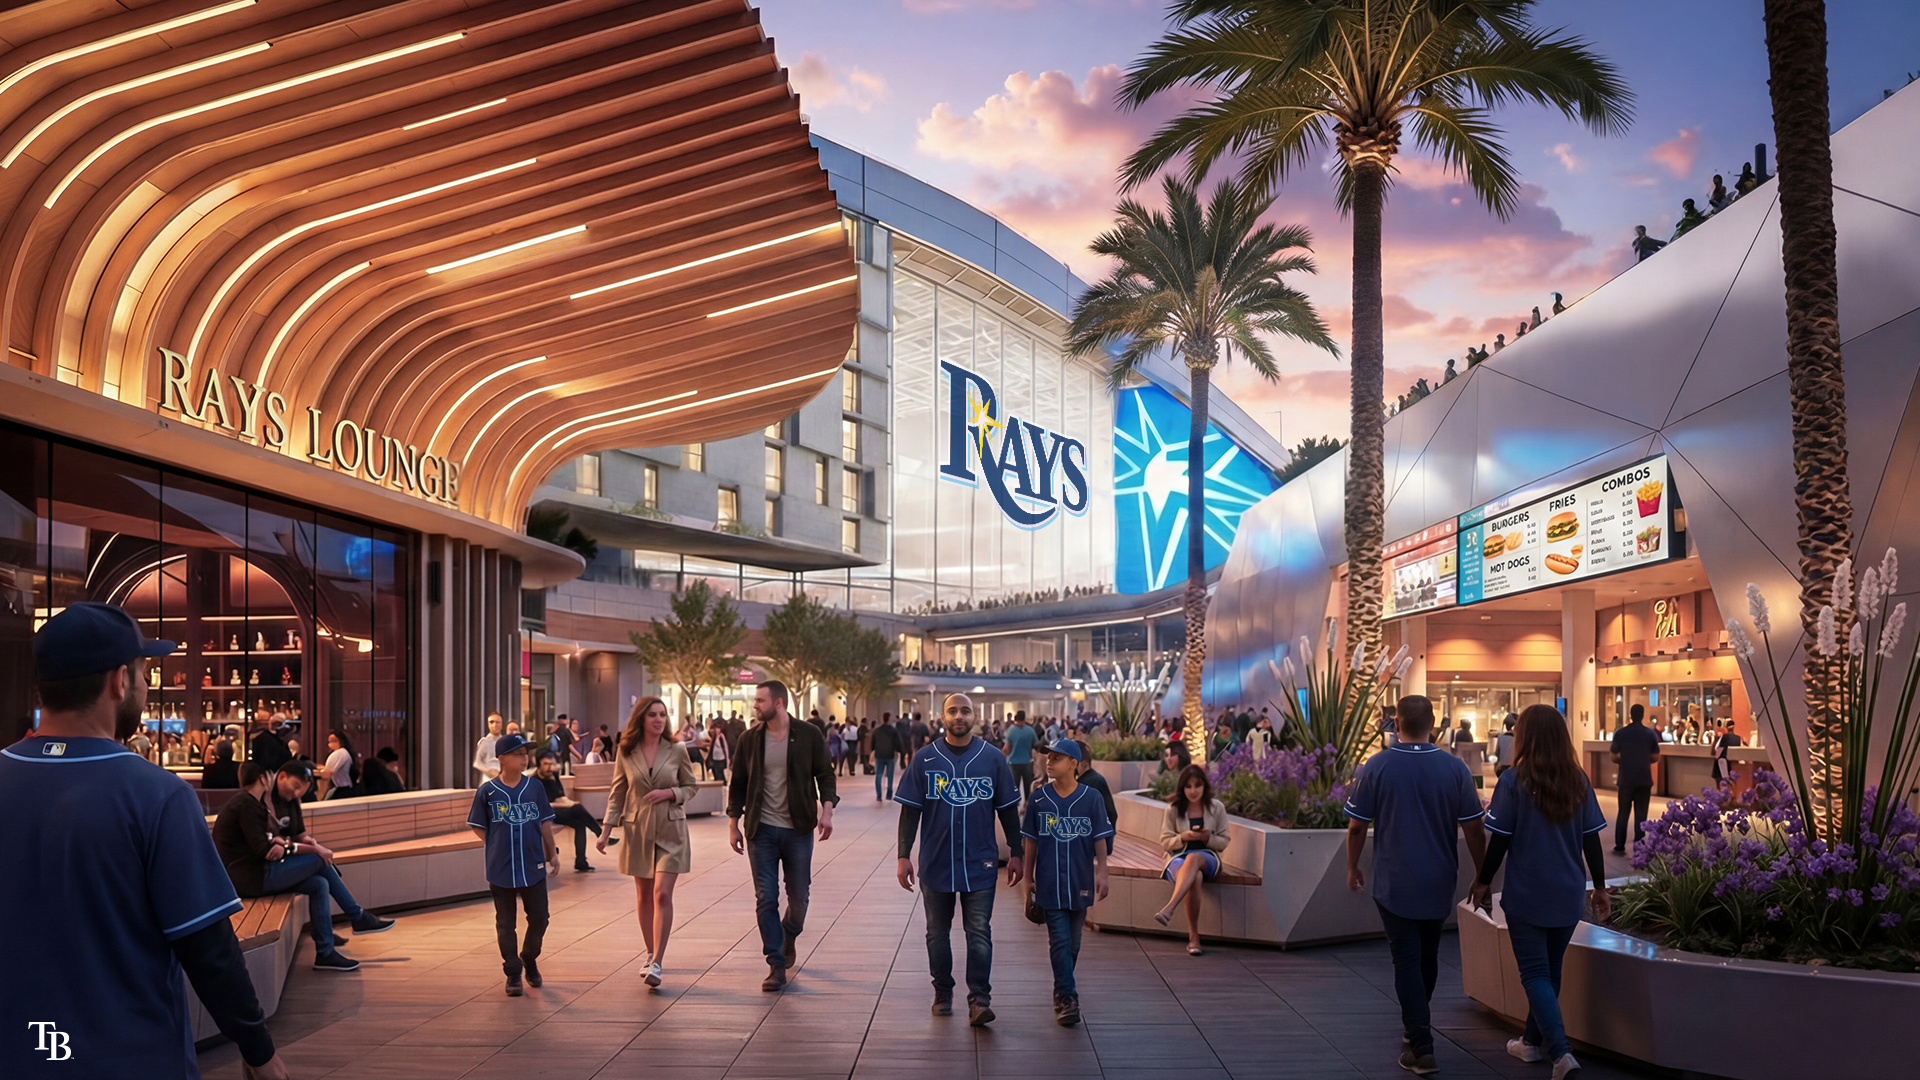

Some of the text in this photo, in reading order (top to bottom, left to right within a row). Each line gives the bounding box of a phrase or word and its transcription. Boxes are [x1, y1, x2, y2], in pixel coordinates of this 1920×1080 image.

[157, 347, 460, 503] RAYS LOUNGE
[939, 358, 1090, 532] RAYS
[1602, 466, 1651, 492] COMBOS
[1549, 493, 1576, 512] FRIES
[1508, 556, 1530, 570] DOGS
[925, 770, 994, 807] RAYS
[1038, 811, 1093, 842] RAYS
